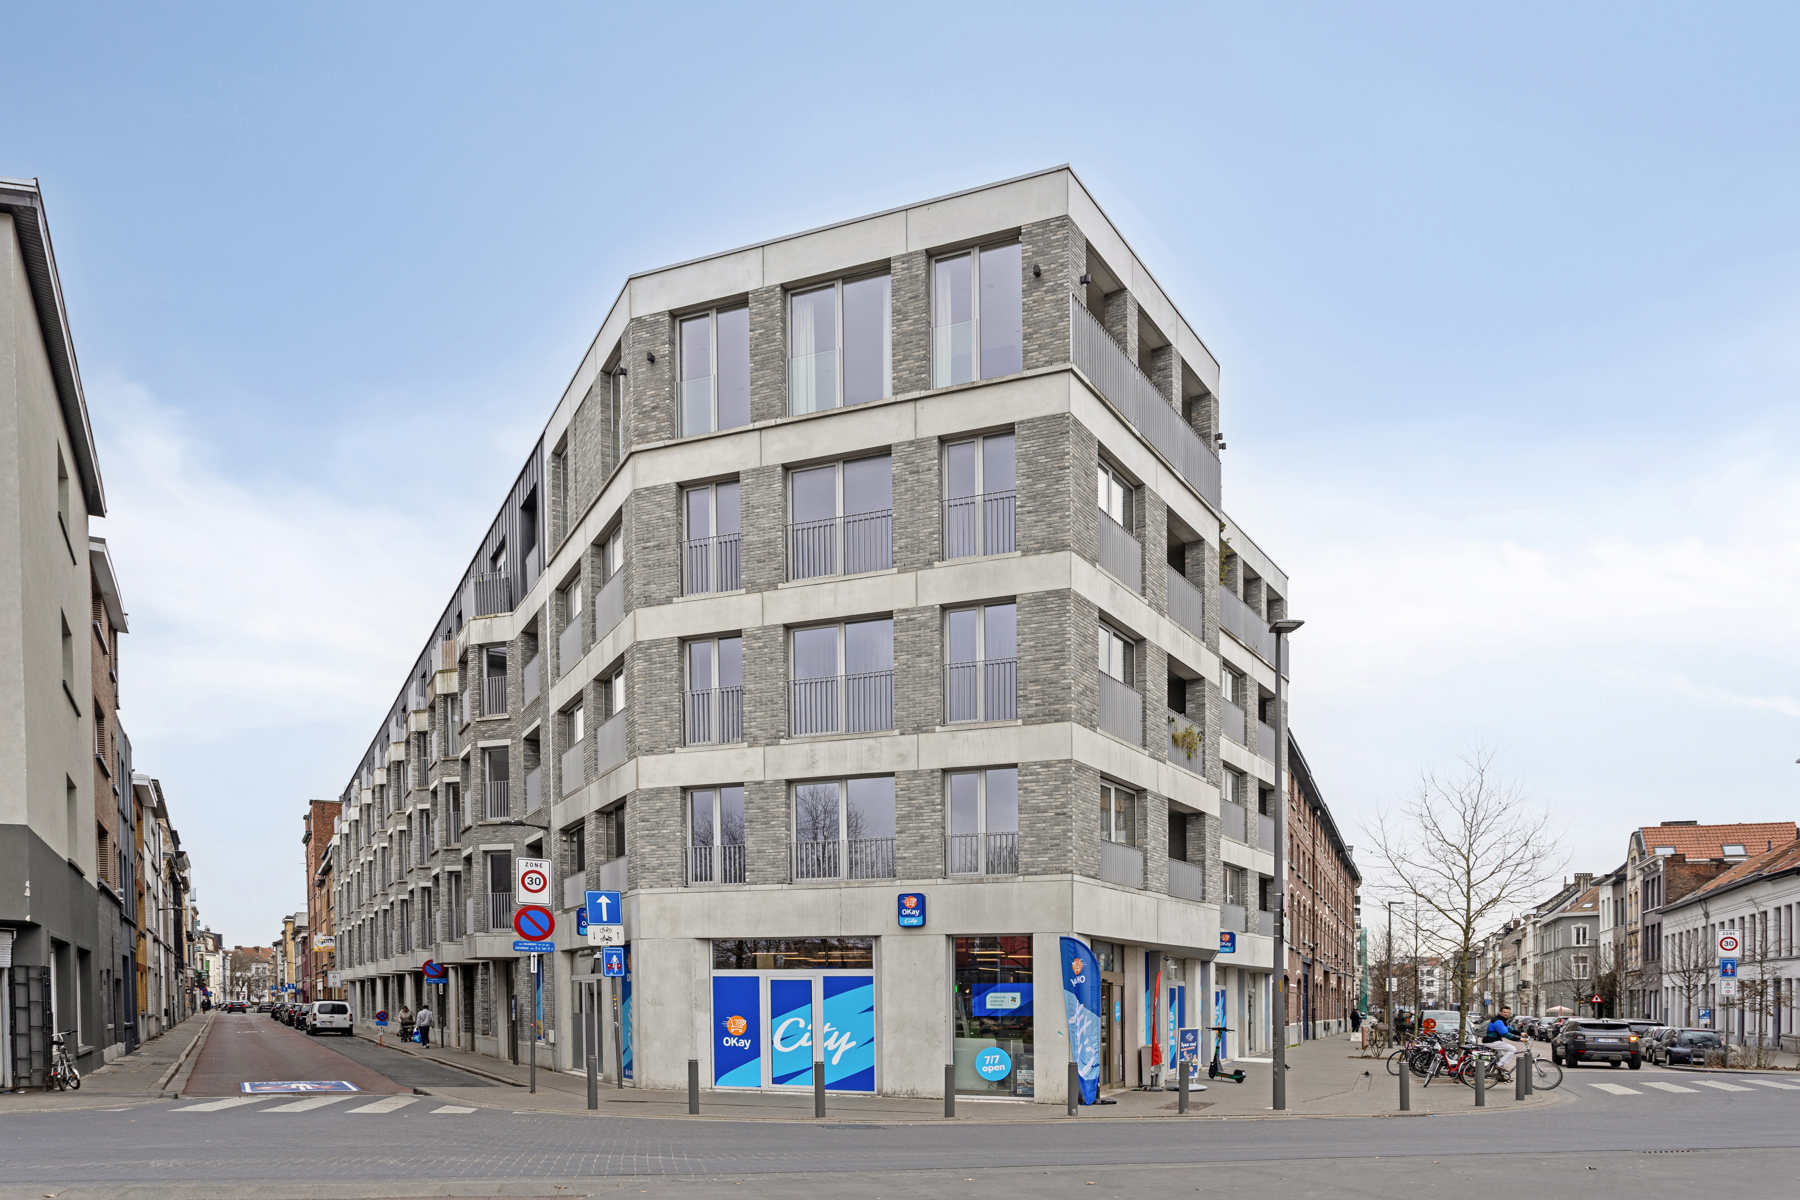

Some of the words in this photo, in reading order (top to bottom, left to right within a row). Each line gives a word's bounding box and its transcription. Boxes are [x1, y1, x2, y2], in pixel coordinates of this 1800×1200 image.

[527, 876, 541, 886] 30
[901, 908, 920, 917] OKay
[722, 1036, 752, 1050] OKay
[772, 1017, 857, 1065] City
[982, 1064, 1006, 1074] open
